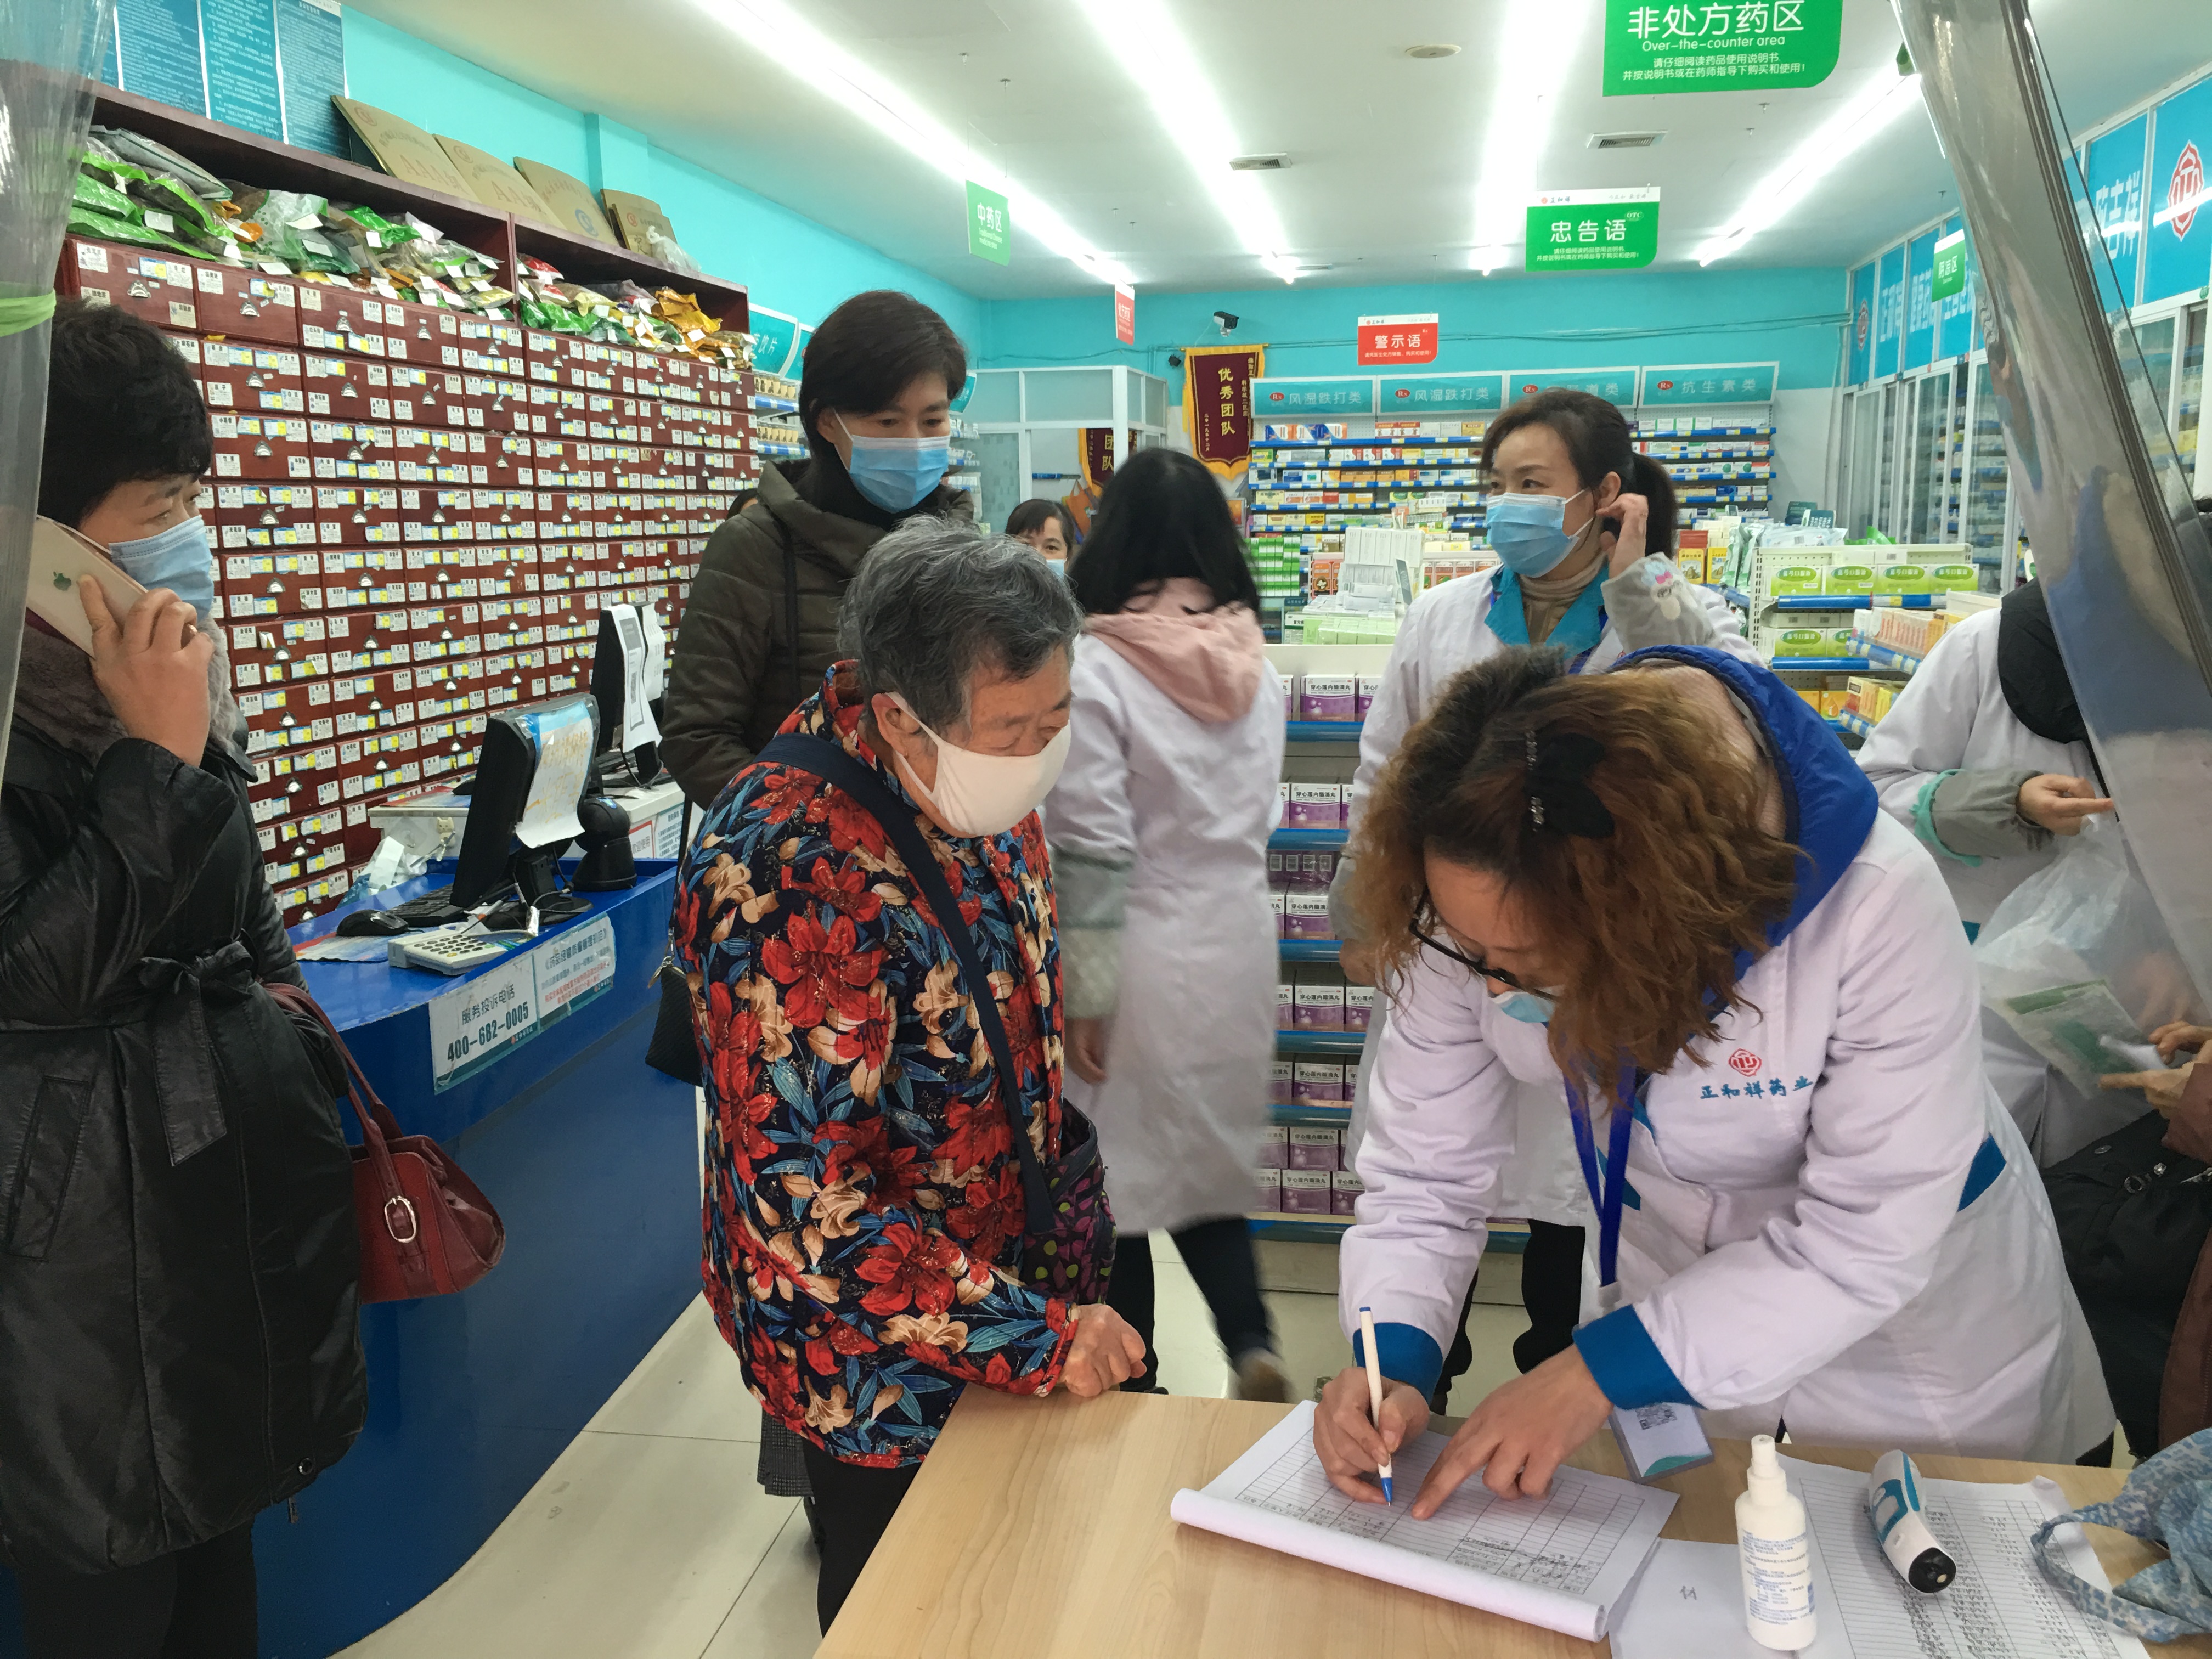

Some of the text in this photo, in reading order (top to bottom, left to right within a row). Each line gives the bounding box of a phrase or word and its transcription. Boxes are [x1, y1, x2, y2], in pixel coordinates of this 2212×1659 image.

[1627, 0, 1805, 39] 非处方药区
[1642, 35, 1786, 52] Over-the-counter area
[977, 202, 1002, 233] 中药区
[1550, 219, 1627, 242] 忠告语
[1374, 334, 1421, 349] 警示语
[1414, 387, 1489, 402] 风湿跌打类
[1681, 378, 1757, 394] 抗生素类
[1217, 368, 1236, 436] 优秀团队
[1288, 391, 1362, 405] 风湿跌打类
[461, 984, 515, 1025] 服务投诉电话
[447, 1001, 529, 1062] 400-682-0005
[1700, 1075, 1813, 1099] 正和祥药业
